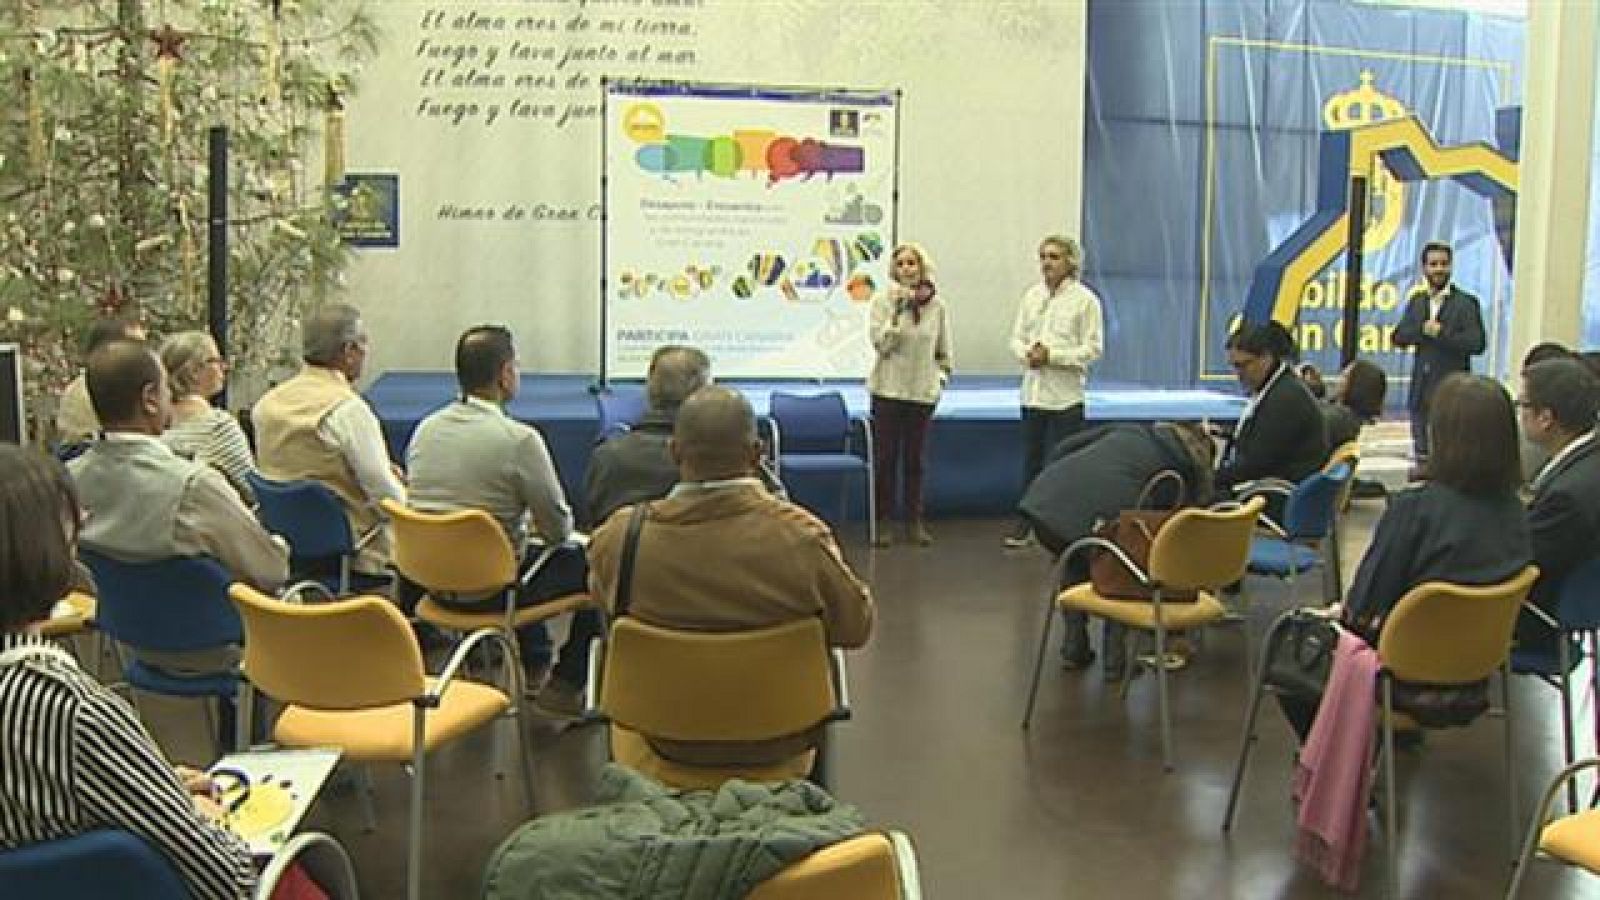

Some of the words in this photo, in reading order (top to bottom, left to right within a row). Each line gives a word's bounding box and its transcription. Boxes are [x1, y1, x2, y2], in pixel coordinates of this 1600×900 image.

[420, 9, 446, 30] El
[452, 10, 505, 31] alma
[514, 17, 556, 31] eres
[565, 13, 590, 32] de
[600, 19, 626, 33] mi
[416, 38, 478, 67] Fuego
[485, 47, 499, 68] y
[510, 40, 556, 60] lava
[556, 45, 617, 70] junto
[625, 45, 651, 61] al
[420, 68, 446, 88] El
[452, 69, 505, 88] alma
[514, 74, 556, 89] eres
[565, 71, 589, 90] de
[416, 97, 478, 125] Fuego
[485, 105, 499, 126] y
[510, 97, 556, 117] lava
[556, 103, 601, 128] jun
[502, 203, 525, 221] de
[532, 203, 579, 221] Gran
[1302, 270, 1398, 311] bildo
